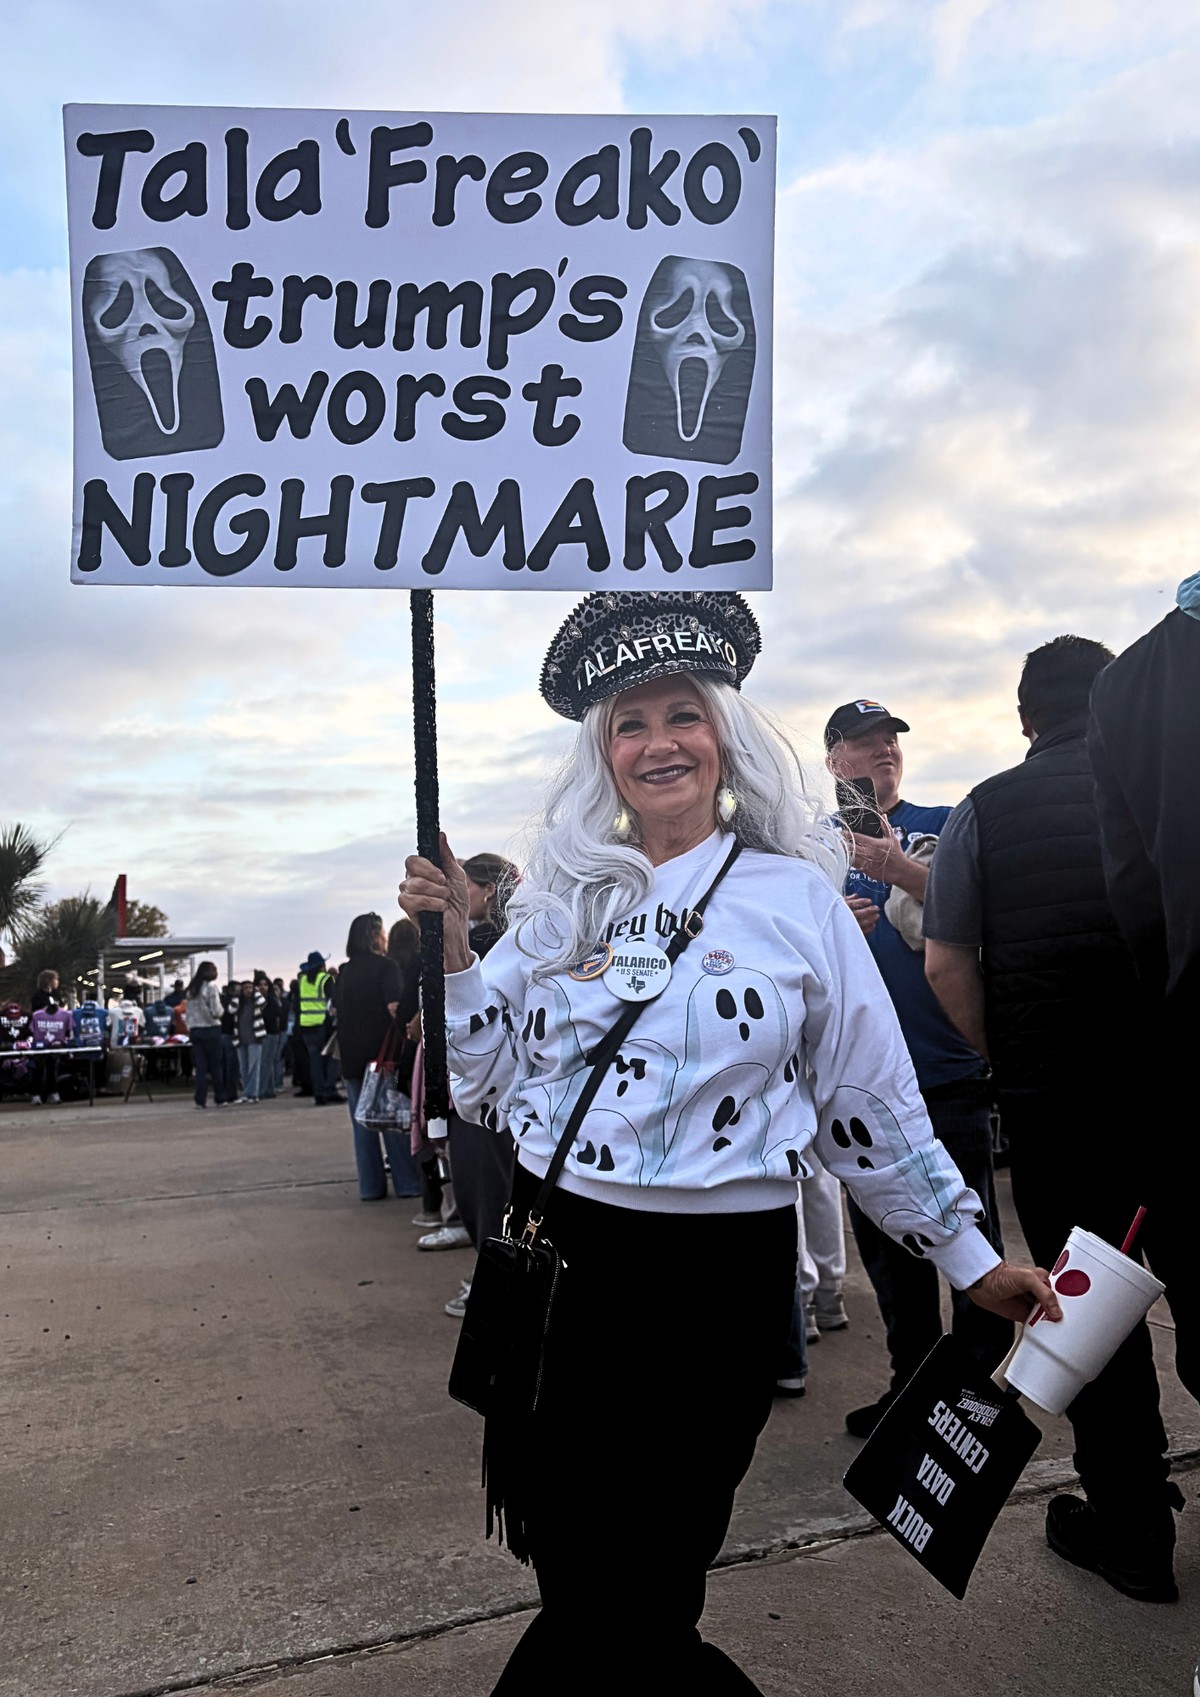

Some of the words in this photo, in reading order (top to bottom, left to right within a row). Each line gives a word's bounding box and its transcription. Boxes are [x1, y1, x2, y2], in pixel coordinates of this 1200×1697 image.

[212, 256, 628, 371] trump's
[245, 364, 583, 447] worst
[76, 471, 760, 577] NIGHTMARE
[611, 955, 667, 970] TALARICO
[631, 969, 654, 978] SENATE
[928, 1400, 990, 1474] CENTERS
[915, 1453, 956, 1506] DATA
[886, 1494, 934, 1554] BUCK
